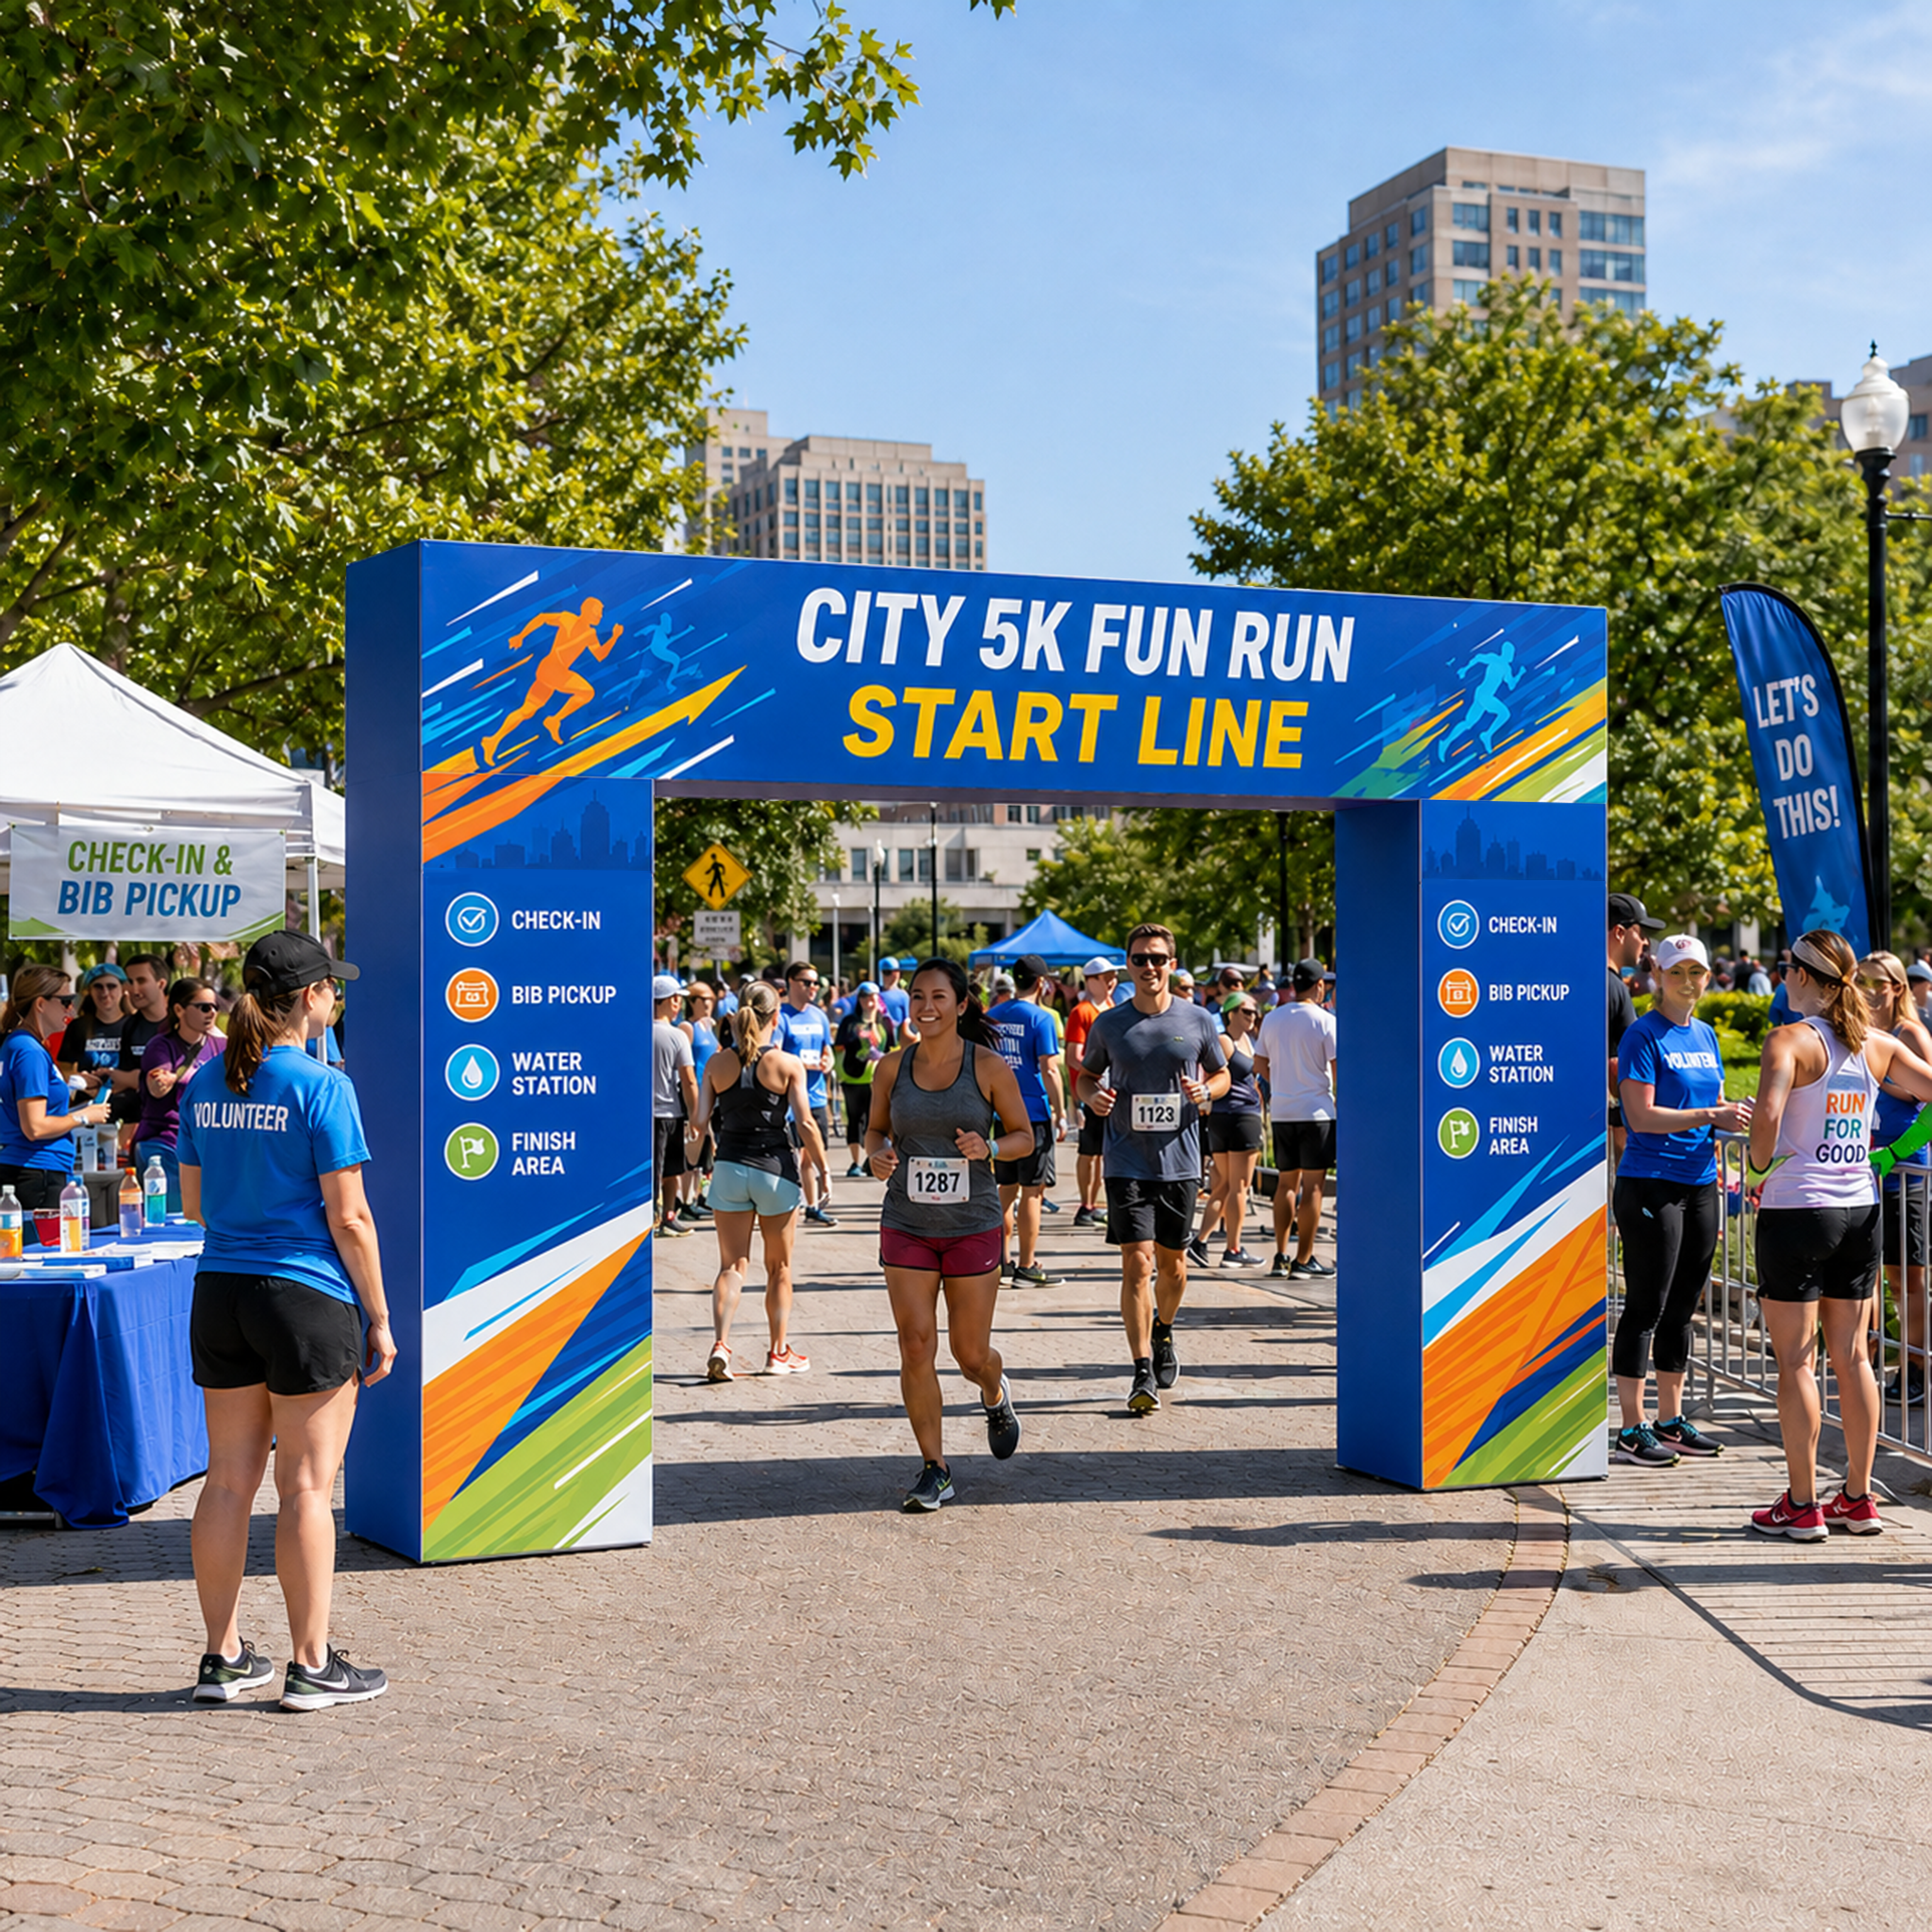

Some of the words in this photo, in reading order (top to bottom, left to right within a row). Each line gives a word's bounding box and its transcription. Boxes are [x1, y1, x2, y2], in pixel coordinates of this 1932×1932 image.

[796, 587, 966, 668] CITY
[978, 597, 1073, 672] 5K
[1084, 604, 1213, 678] FUN
[1226, 610, 1355, 683] RUN
[1753, 674, 1820, 729] LET'S
[841, 684, 1120, 763] START
[1137, 695, 1309, 769] LINE
[1774, 734, 1814, 781] DO
[1774, 785, 1841, 840] THIS!
[68, 840, 206, 875] CHECK-IN
[213, 844, 233, 876] &
[57, 879, 114, 915] BIB
[124, 882, 242, 918] PICKUP
[511, 910, 601, 929] CHECK-IN
[1489, 916, 1557, 933] CHECK-IN
[511, 986, 543, 1004] BIB
[547, 986, 617, 1004] PICKUP
[1489, 984, 1514, 1001] BIB
[1516, 984, 1571, 1002] PICKUP
[511, 1052, 582, 1072] WATER
[1489, 1044, 1543, 1062] WATER
[1489, 1065, 1555, 1084] STATION
[511, 1075, 597, 1096] STATION
[1825, 1092, 1866, 1114] RUN
[193, 1101, 289, 1132] VOLUNTEER
[1138, 1106, 1174, 1123] 1123
[1489, 1116, 1539, 1135] FINISH
[1823, 1118, 1862, 1140] FOR
[511, 1131, 576, 1151] FINISH
[1489, 1138, 1530, 1156] AREA
[1815, 1143, 1867, 1164] GOOD
[511, 1157, 566, 1176] AREA
[914, 1172, 960, 1193] 1287
